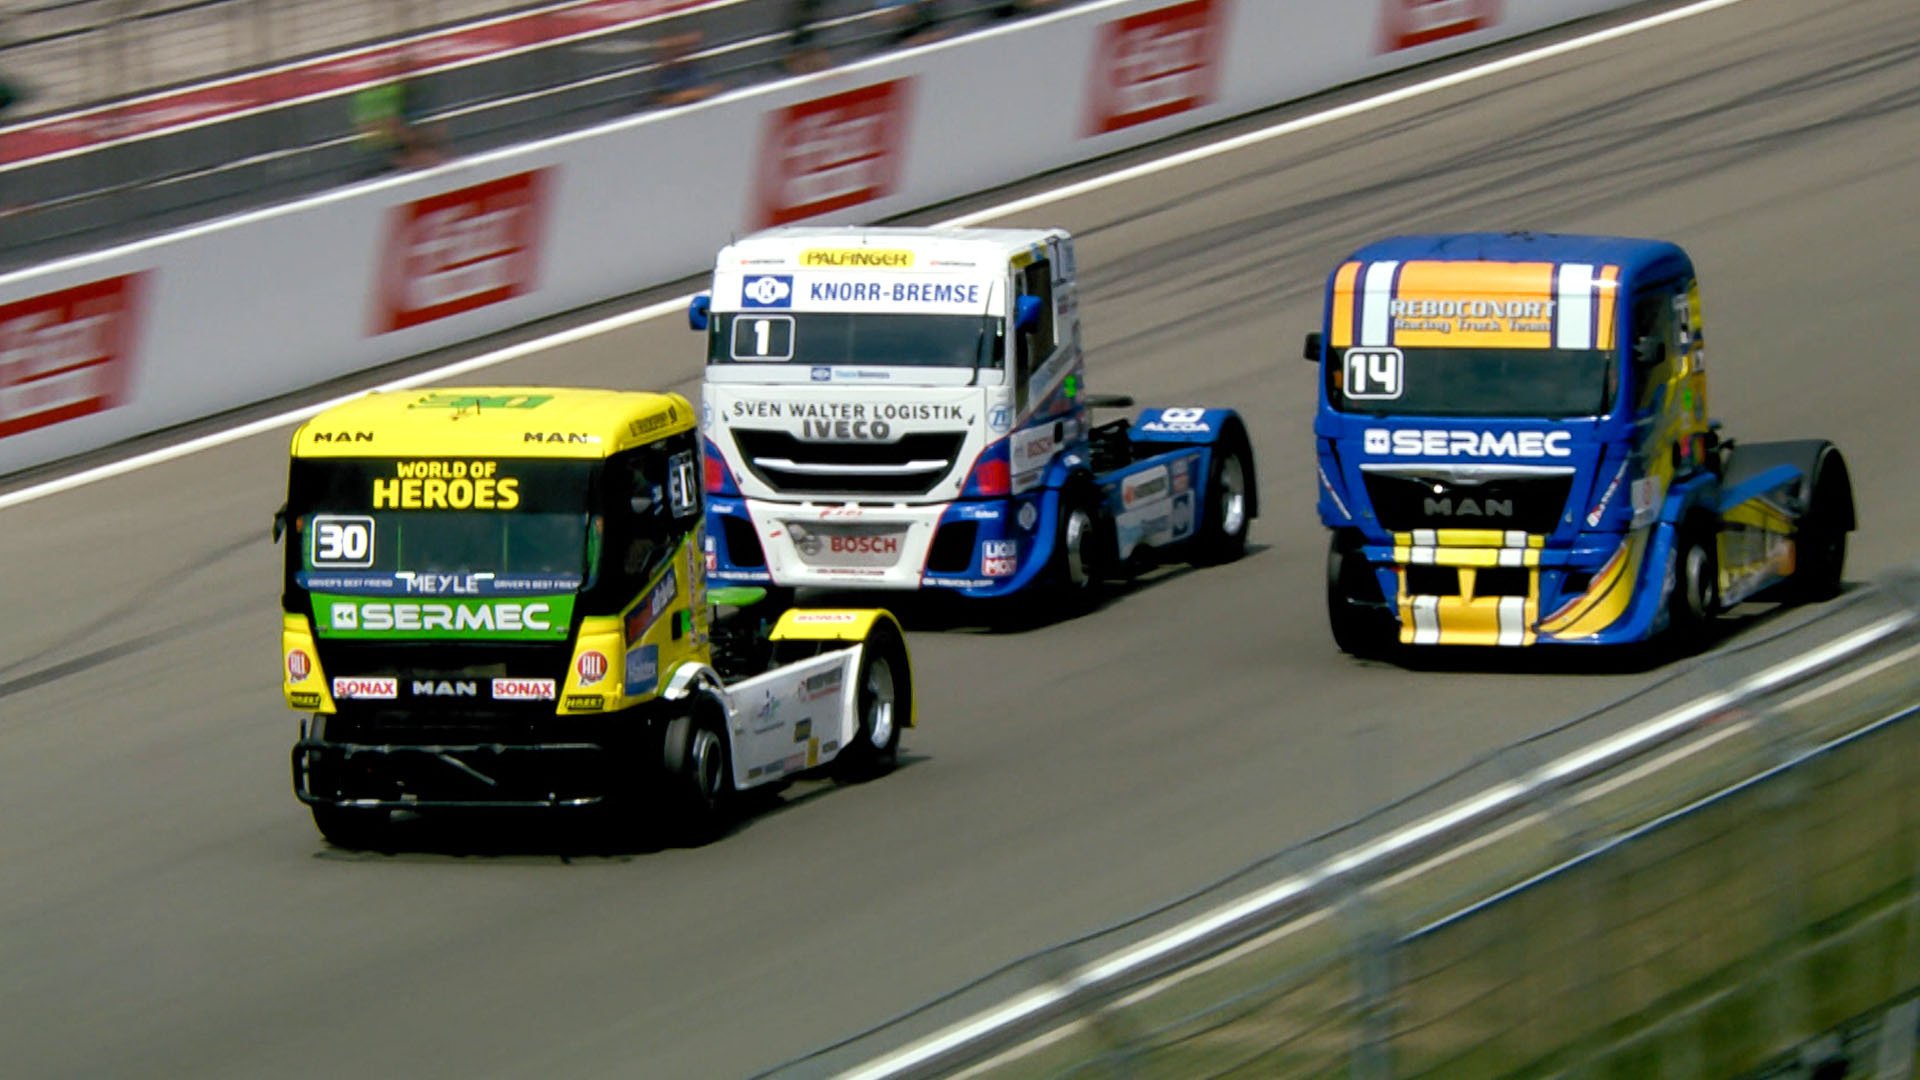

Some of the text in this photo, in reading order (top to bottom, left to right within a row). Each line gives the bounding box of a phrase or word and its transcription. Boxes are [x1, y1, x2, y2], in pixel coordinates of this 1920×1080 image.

[806, 252, 907, 266] PALFINGER
[810, 282, 980, 304] KNORR-BREMSE
[1389, 299, 1556, 318] REBOCONORT
[754, 319, 770, 356] 1
[1350, 353, 1398, 393] 14
[734, 402, 963, 420] SVEN WALTER LOGISTIK
[313, 431, 374, 443] MAN
[524, 431, 589, 443] MAN
[802, 419, 891, 440] IVECO
[1390, 430, 1572, 456] SERMEC
[396, 462, 497, 479] WORLD OF
[372, 478, 520, 510] HEROES
[1424, 498, 1513, 517] MAN
[318, 524, 369, 561] 30
[830, 536, 897, 554] BOSCH
[406, 574, 479, 595] MEYLE
[361, 603, 552, 631] SERMEC
[335, 681, 395, 697] SONAX
[412, 680, 477, 697] MAN
[494, 681, 553, 697] SONAX
